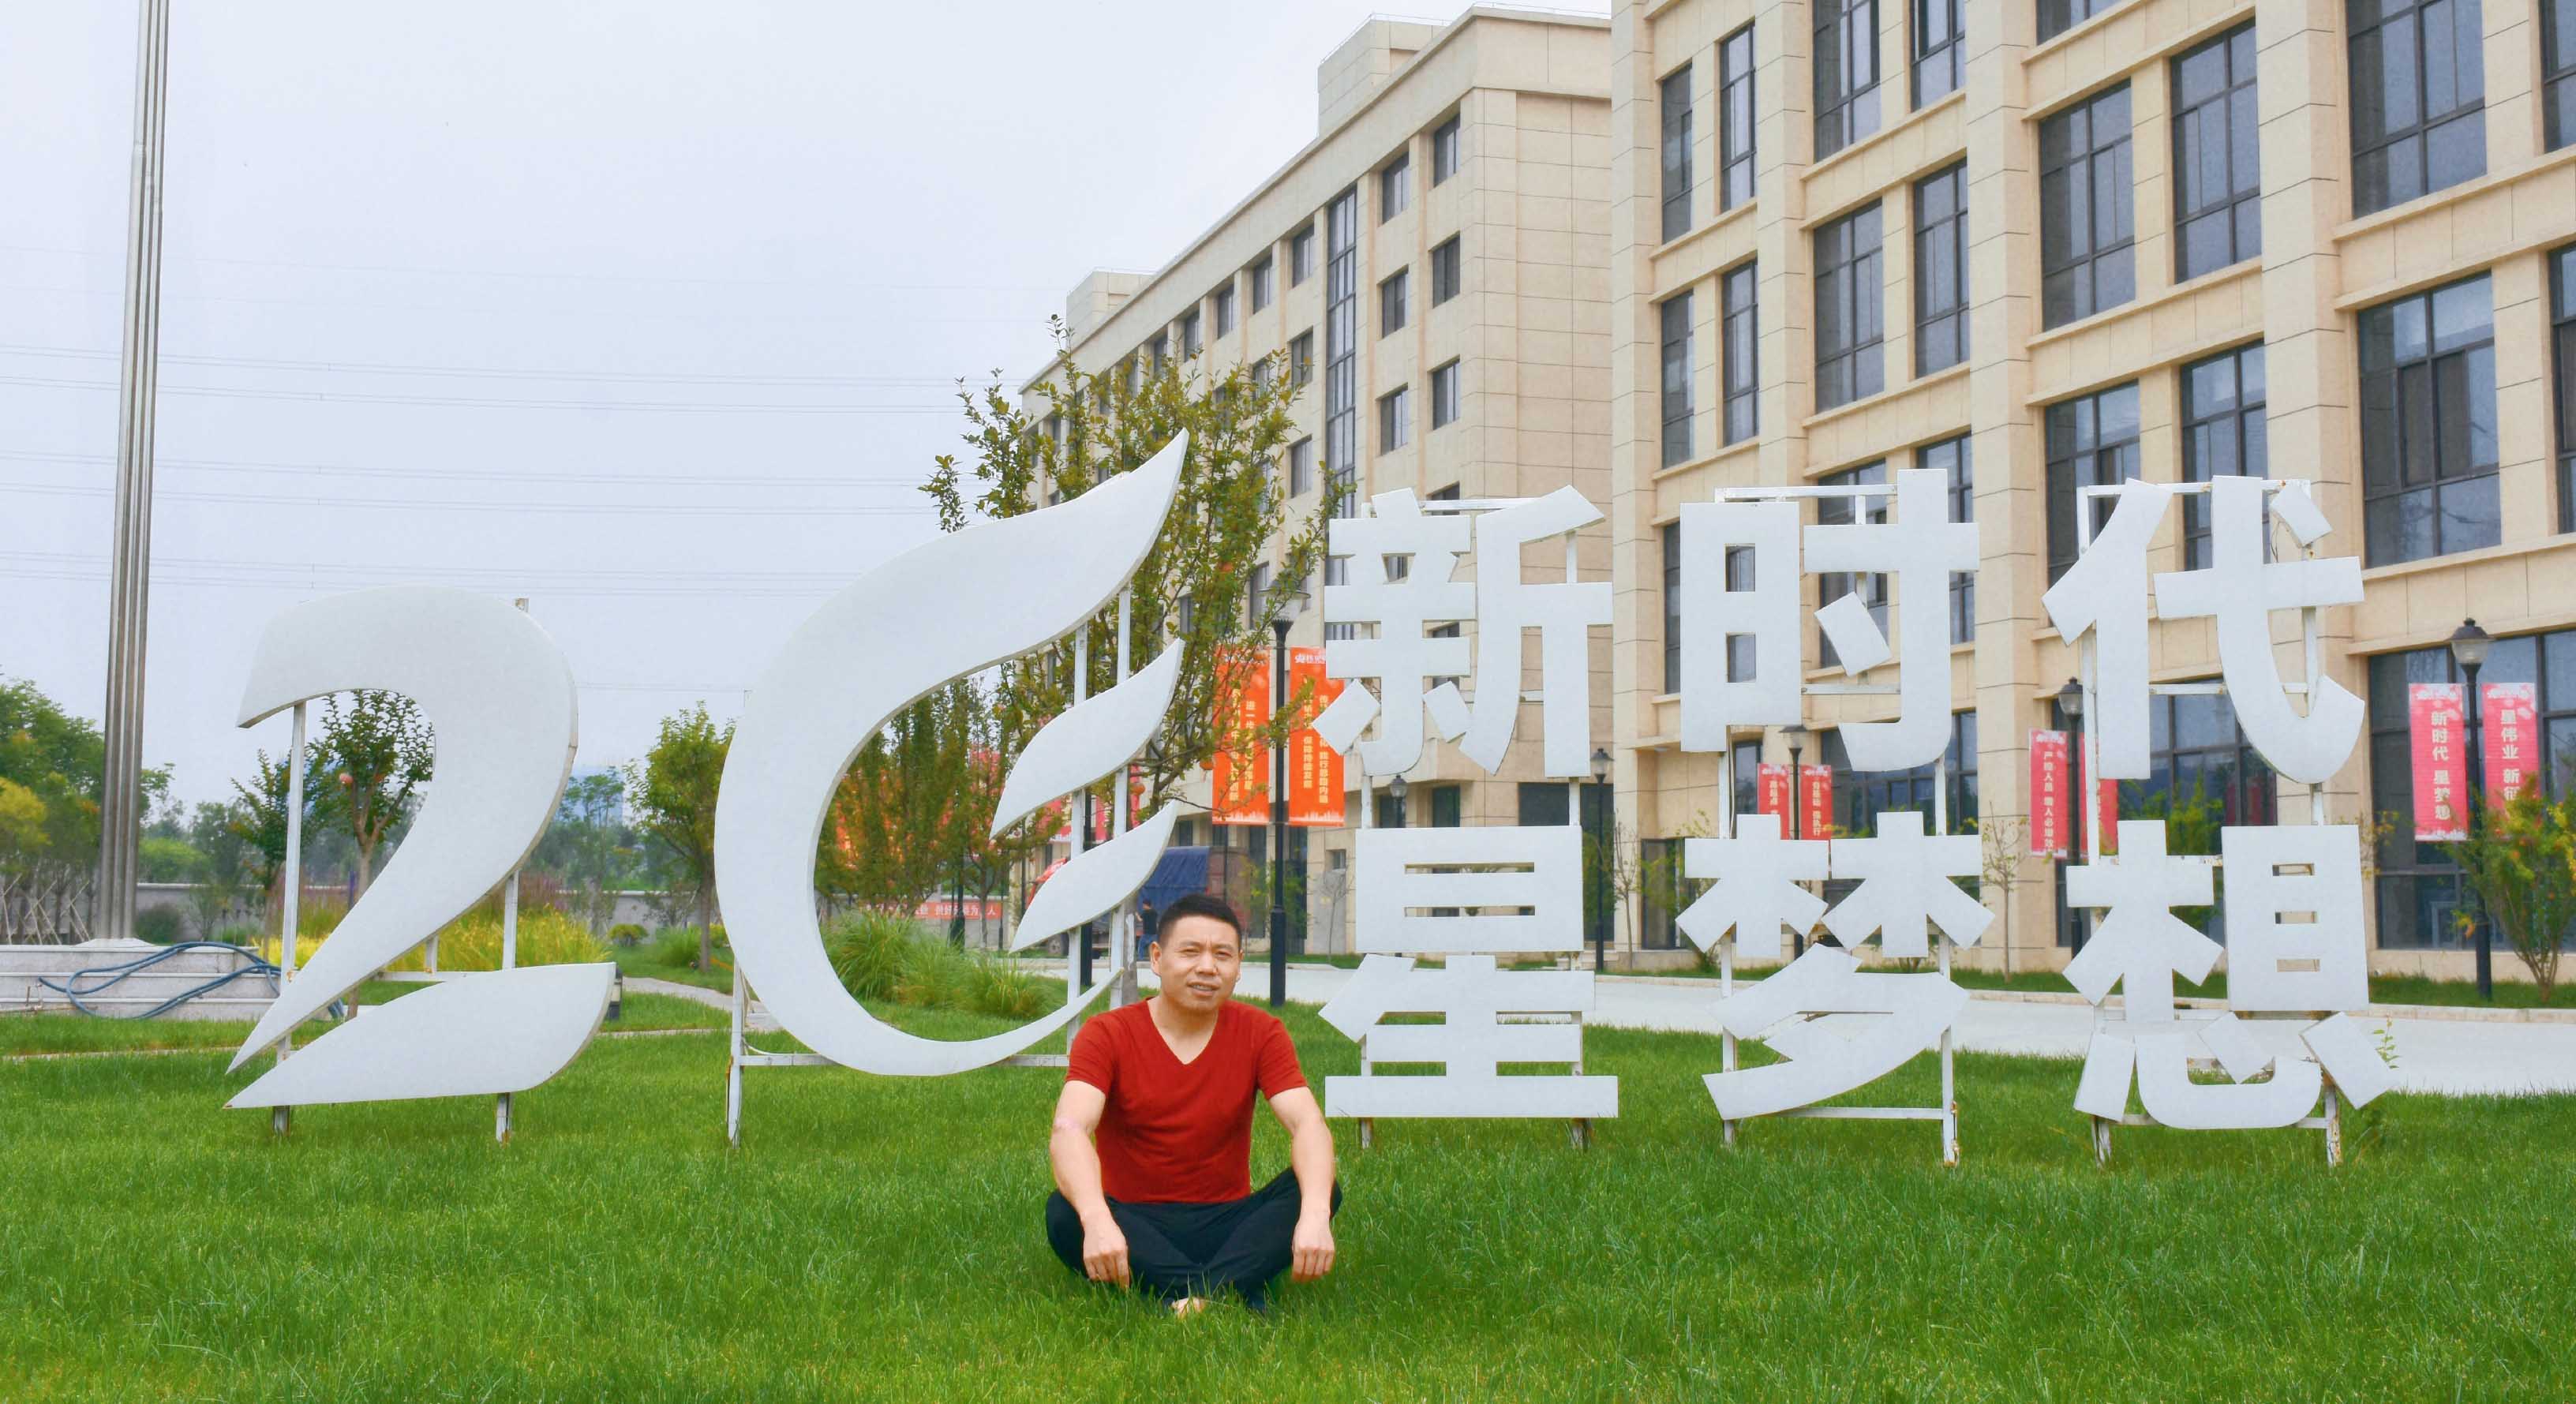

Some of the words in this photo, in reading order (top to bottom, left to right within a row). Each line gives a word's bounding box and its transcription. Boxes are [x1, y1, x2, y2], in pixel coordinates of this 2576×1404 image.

[1313, 468, 2366, 784] 新时代
[2431, 710, 2450, 762] 新时代
[1317, 811, 2399, 1130] 星梦想
